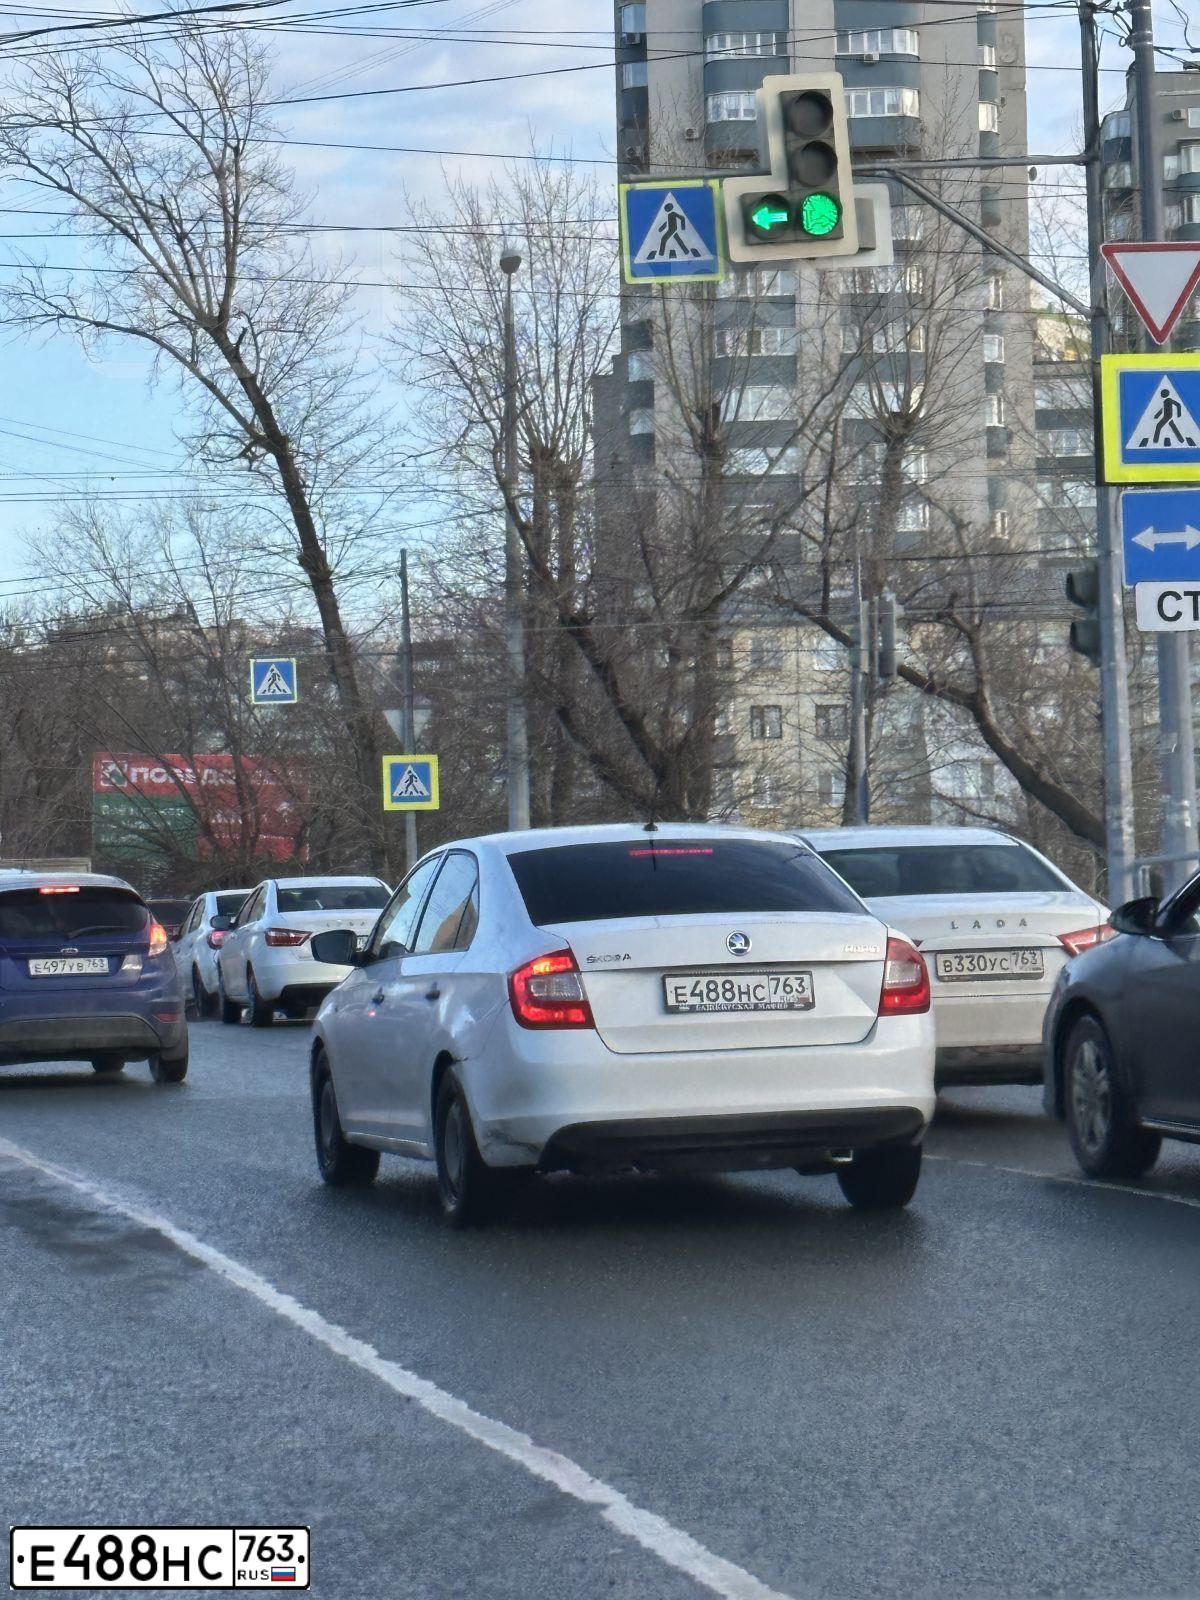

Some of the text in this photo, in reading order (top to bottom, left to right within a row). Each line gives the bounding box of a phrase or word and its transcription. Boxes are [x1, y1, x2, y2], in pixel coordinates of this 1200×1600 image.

[951, 918, 1028, 930] LADA
[942, 951, 1038, 973] В330УС 763
[673, 976, 807, 1004] Е488НС 763
